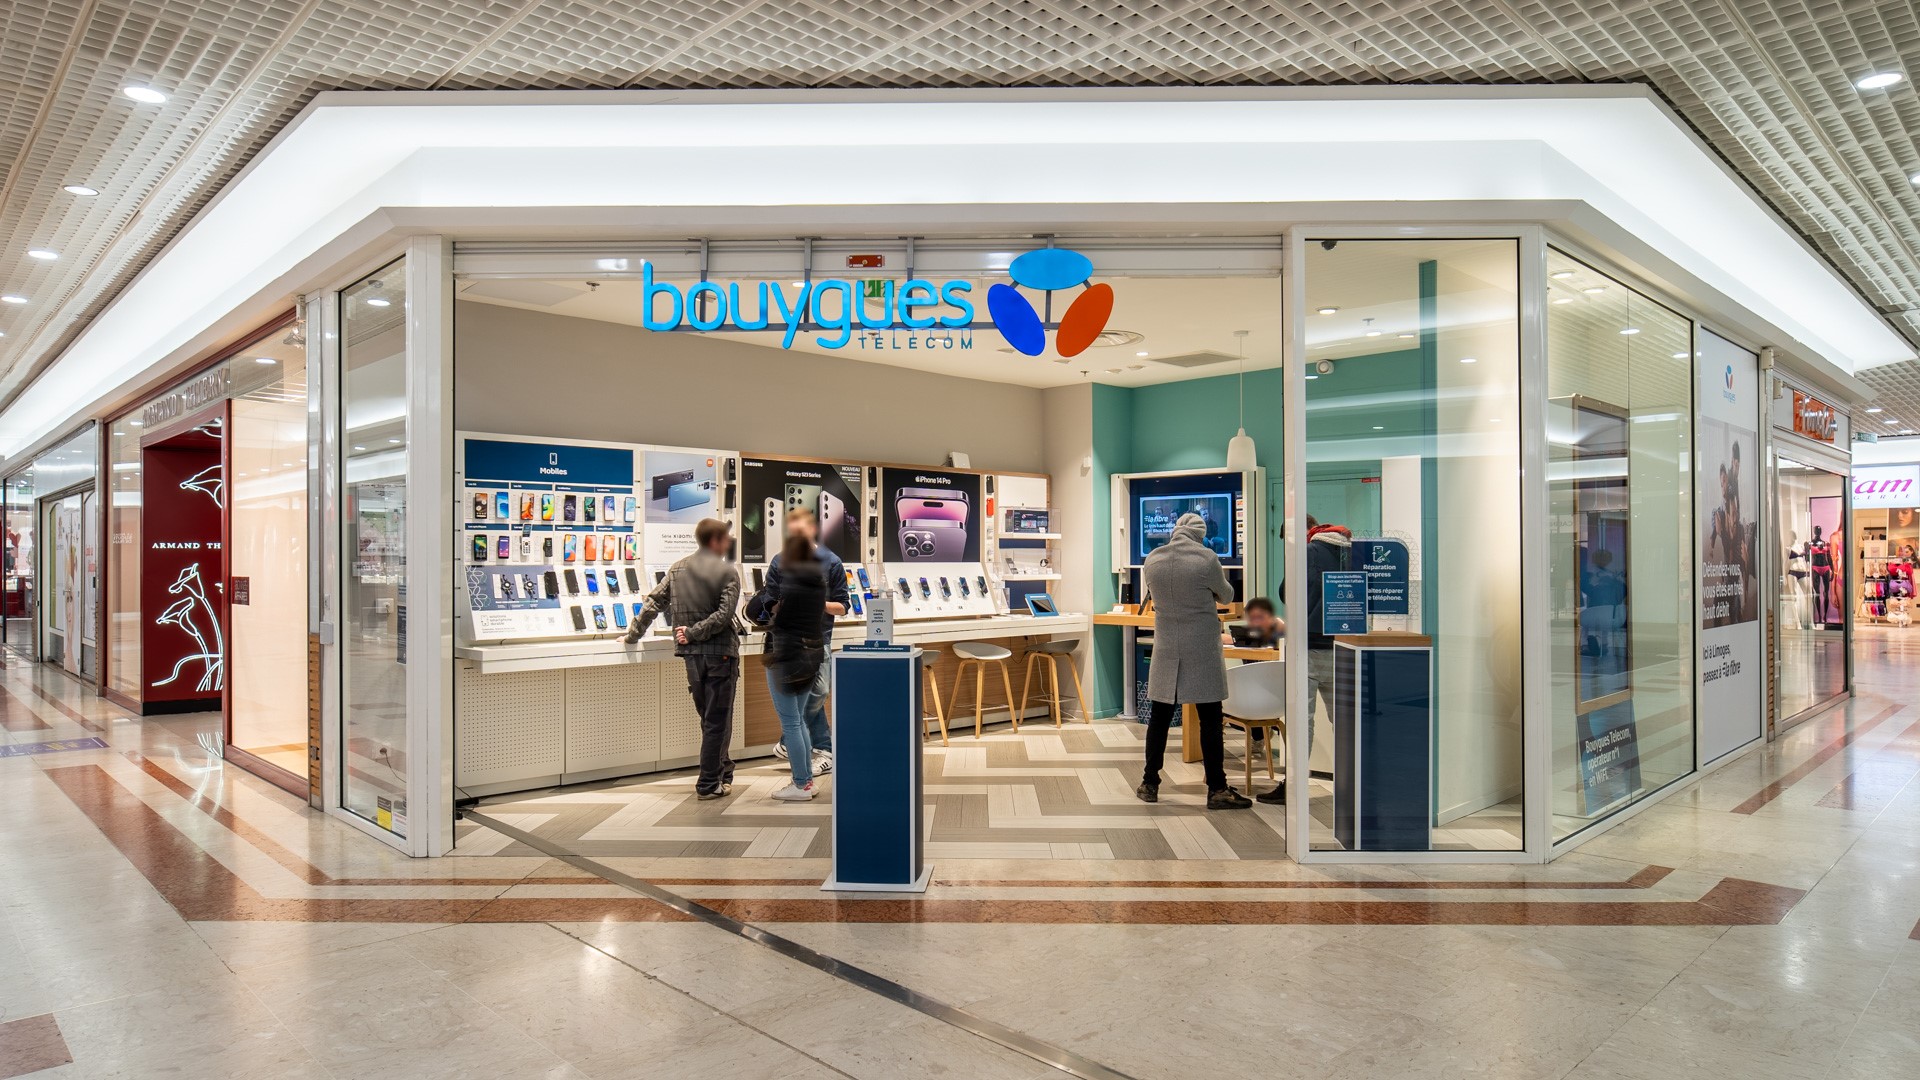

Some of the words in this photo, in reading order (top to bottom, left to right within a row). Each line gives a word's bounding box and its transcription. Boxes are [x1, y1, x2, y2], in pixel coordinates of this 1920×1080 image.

[643, 262, 974, 350] bouygues
[858, 337, 973, 350] TELECOM
[142, 393, 182, 429] ARMAND
[539, 467, 568, 476] Mobiles
[786, 470, 801, 478] Galaxy
[920, 475, 936, 484] iPhone
[942, 477, 951, 485] Pro
[1852, 476, 1913, 494] am
[151, 541, 201, 550] ARMAND
[1703, 585, 1715, 598] vous
[1727, 584, 1733, 596] en
[1716, 601, 1730, 618] débit
[1713, 644, 1731, 659] Limoges,
[1703, 669, 1718, 686] passez
[1730, 660, 1740, 676] fibre
[1585, 735, 1610, 753] Bouygues
[1609, 728, 1632, 743] Telecom,
[1588, 751, 1611, 772] opérateur
[1589, 775, 1596, 787] en
